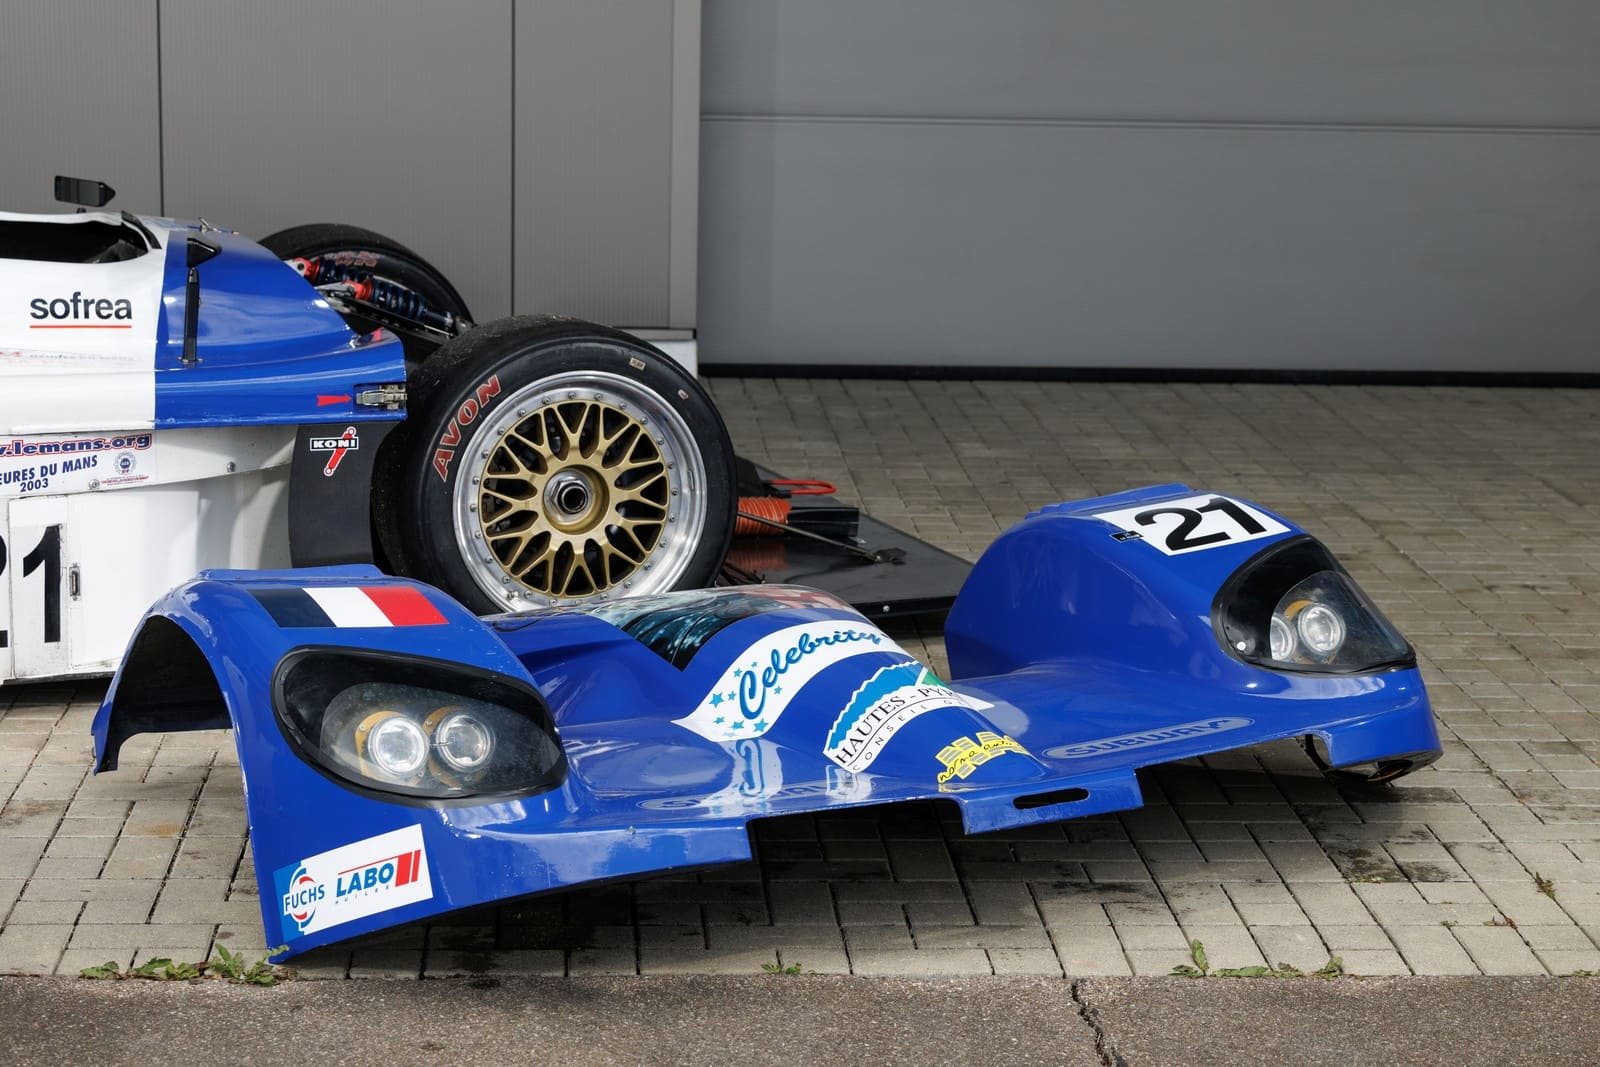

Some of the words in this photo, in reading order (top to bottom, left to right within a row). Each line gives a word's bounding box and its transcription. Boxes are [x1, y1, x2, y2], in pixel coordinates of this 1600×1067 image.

[30, 291, 132, 320] sofrea
[313, 438, 356, 449] KONI
[433, 374, 502, 483] AVON
[40, 463, 57, 478] DU
[62, 455, 97, 473] MANS
[20, 478, 48, 493] 2003
[1134, 497, 1267, 551] 21
[0, 524, 61, 647] 1
[853, 704, 927, 771] CONSEIL
[1065, 719, 1232, 757] SUBWAY
[284, 884, 325, 912] FUCHS
[336, 862, 395, 898] LABO
